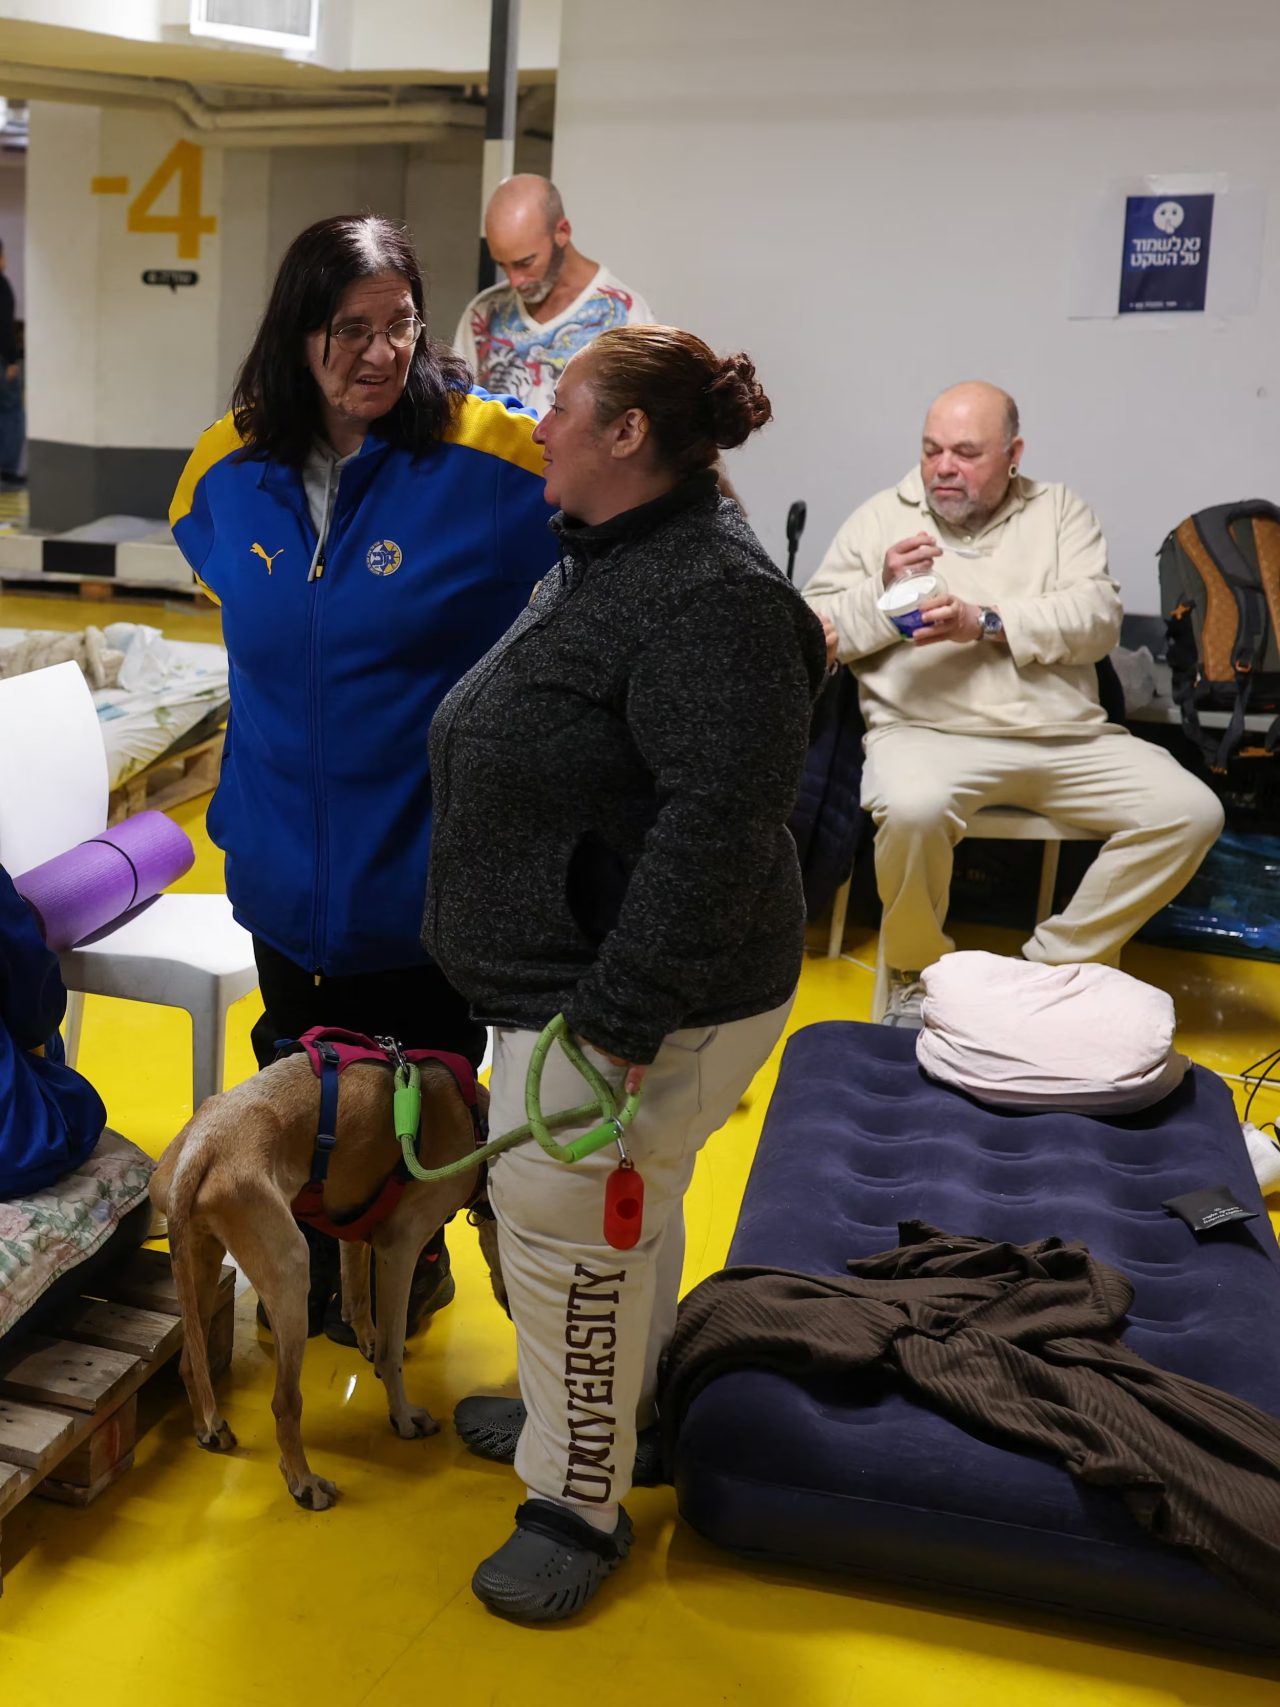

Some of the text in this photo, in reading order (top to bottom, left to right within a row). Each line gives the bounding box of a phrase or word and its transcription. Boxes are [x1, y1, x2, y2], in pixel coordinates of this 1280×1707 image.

[91, 139, 217, 259] -4
[1131, 251, 1200, 269] על השקט
[1182, 237, 1201, 252] נא
[562, 1263, 627, 1504] UNIVERSITY
